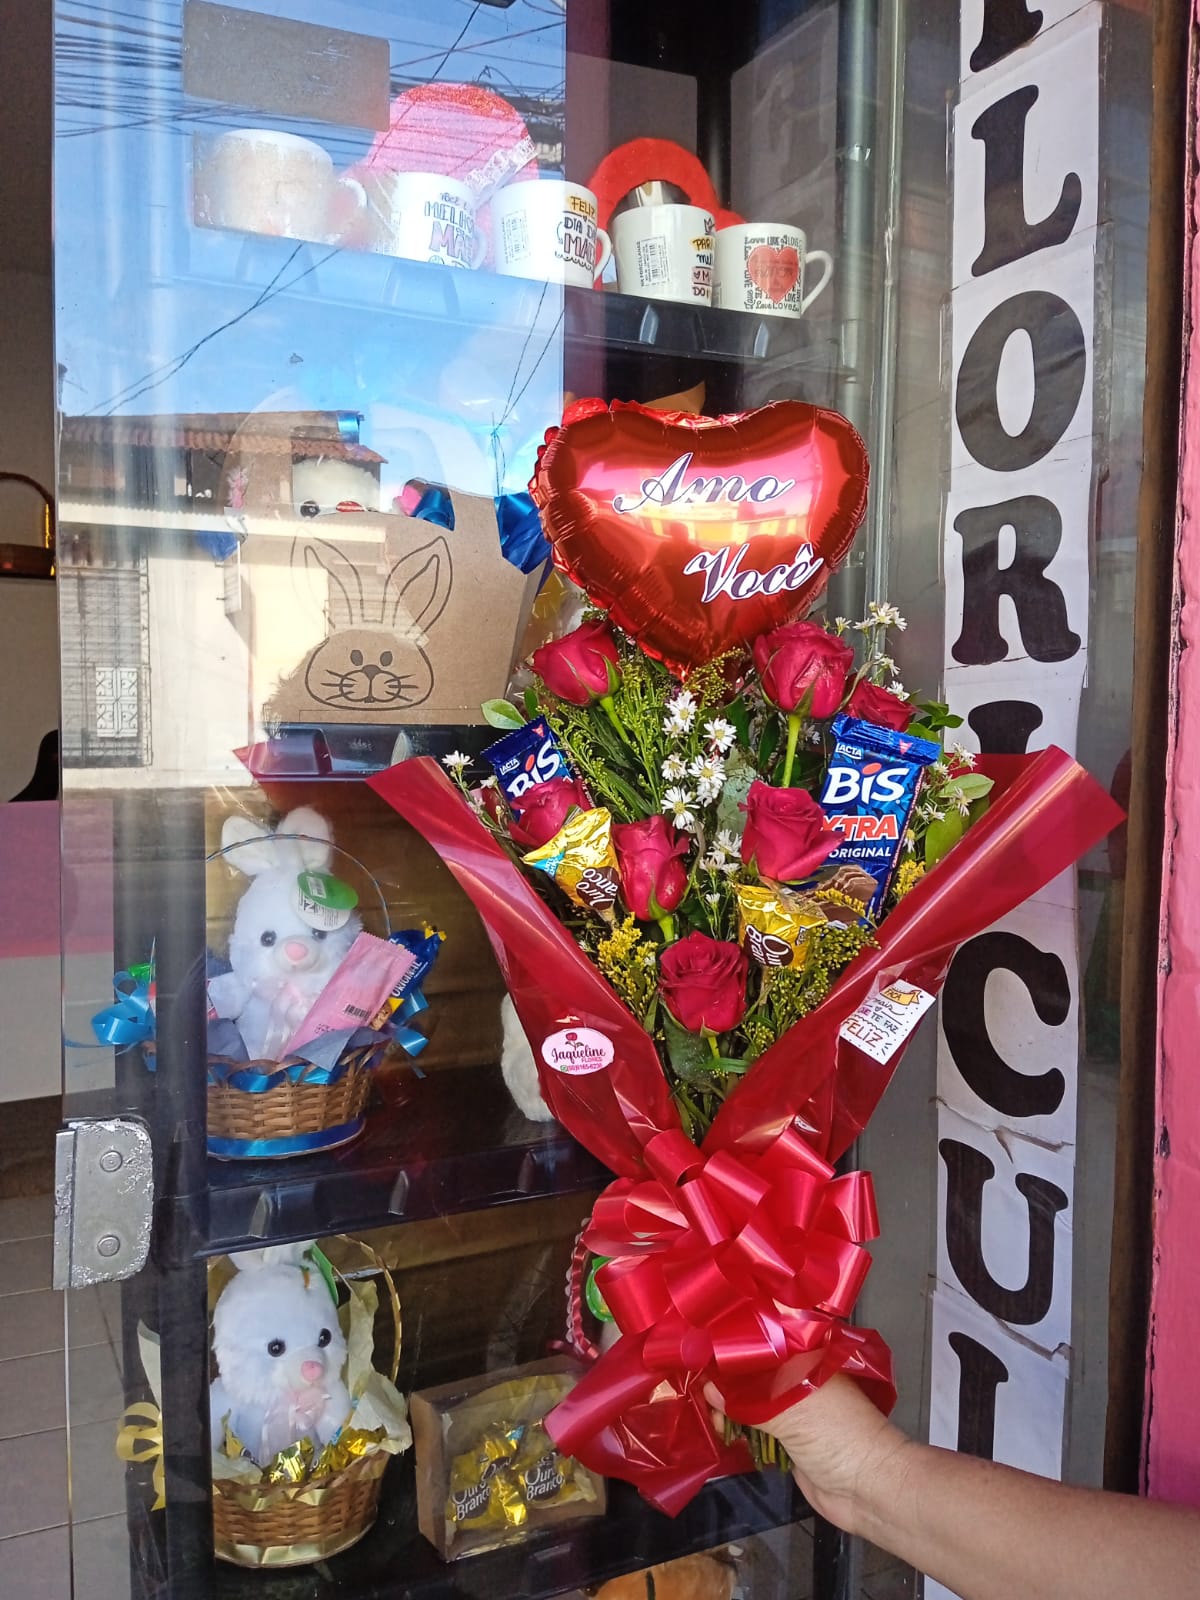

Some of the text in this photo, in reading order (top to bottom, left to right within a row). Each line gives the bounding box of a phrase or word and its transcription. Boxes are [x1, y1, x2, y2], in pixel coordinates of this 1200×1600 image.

[613, 452, 795, 513] Amo
[684, 543, 824, 603] Você
[835, 743, 863, 760] LACTA
[828, 846, 892, 859] ORIGINAL
[551, 1044, 607, 1064] Jaqueline
